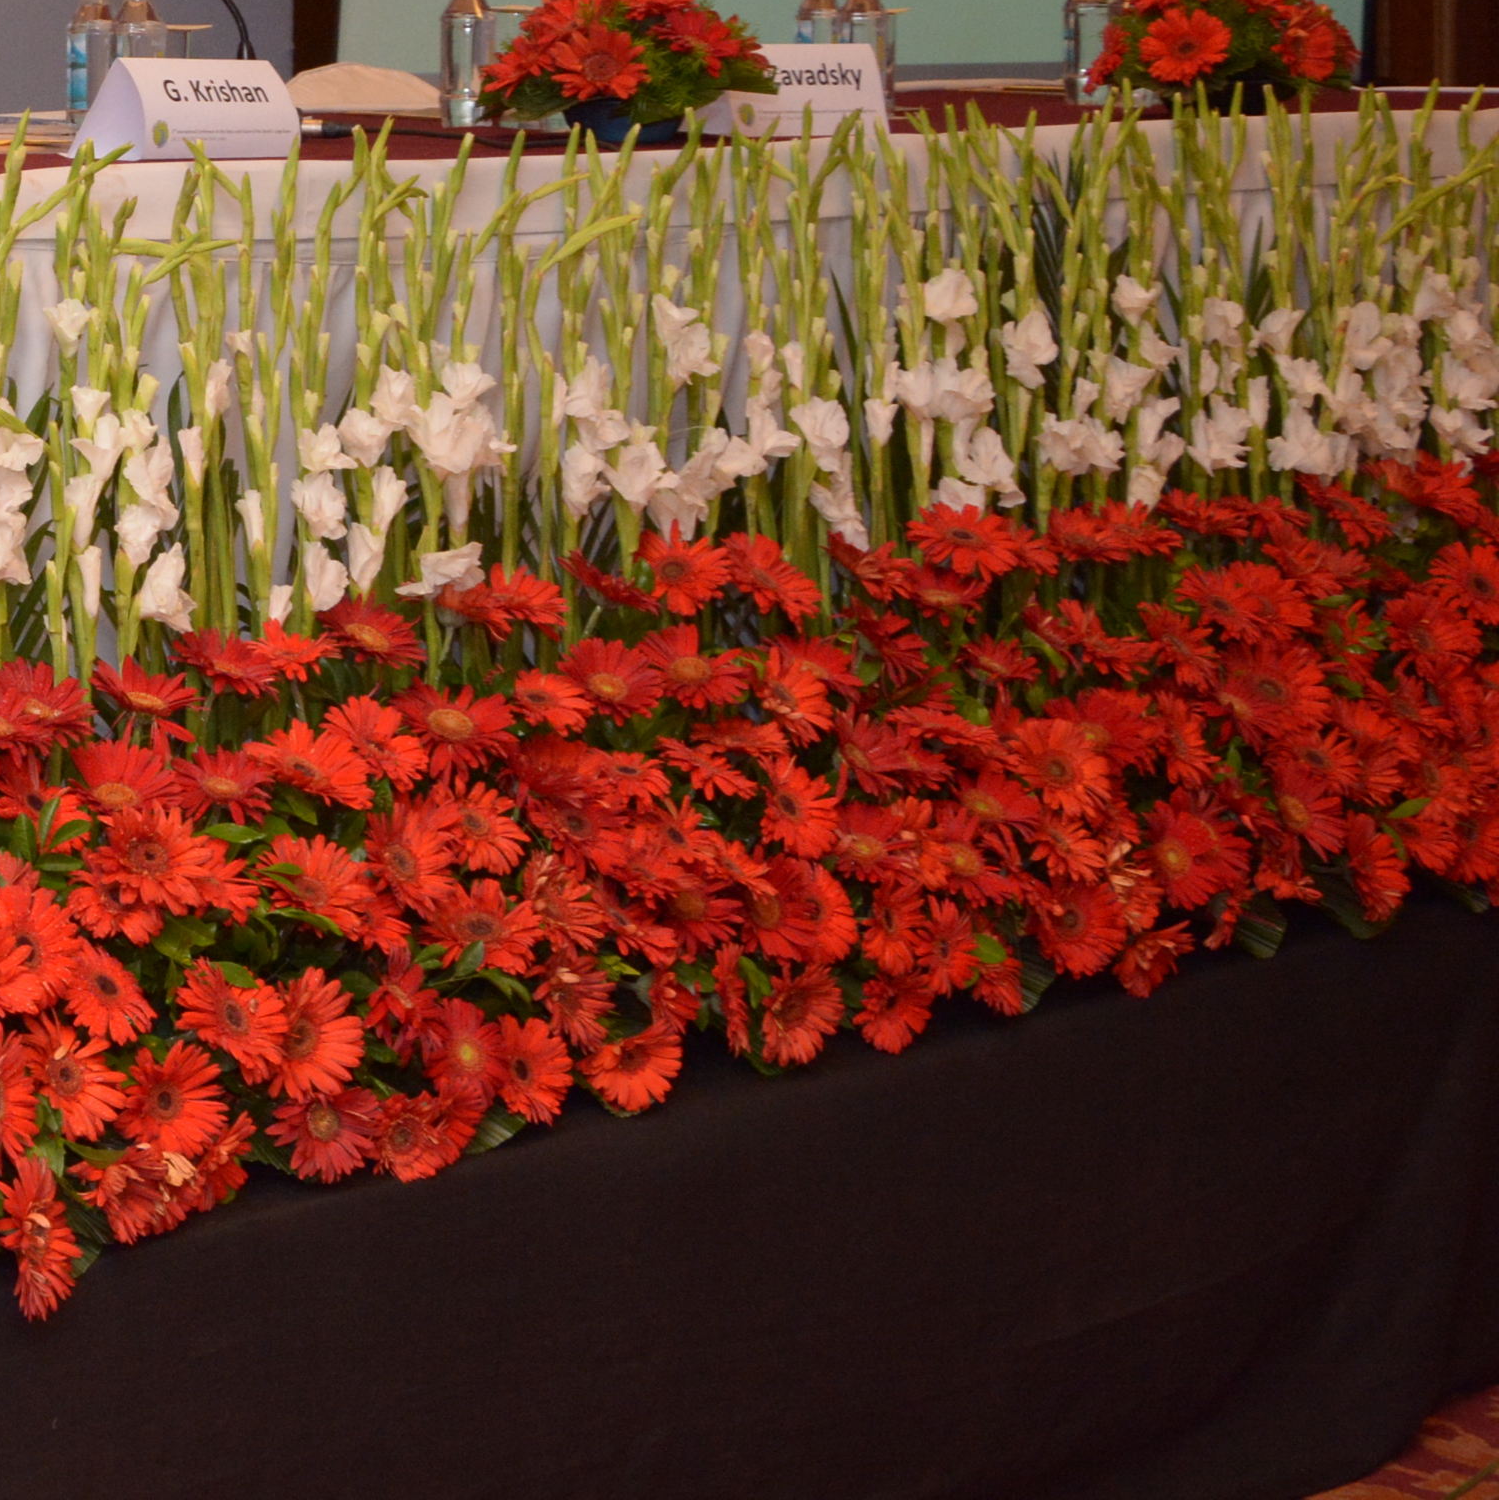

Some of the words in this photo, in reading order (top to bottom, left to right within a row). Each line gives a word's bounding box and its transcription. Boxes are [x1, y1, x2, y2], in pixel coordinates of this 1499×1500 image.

[775, 63, 862, 91] avadsky
[163, 80, 188, 103] G.
[190, 80, 269, 104] Krishan
